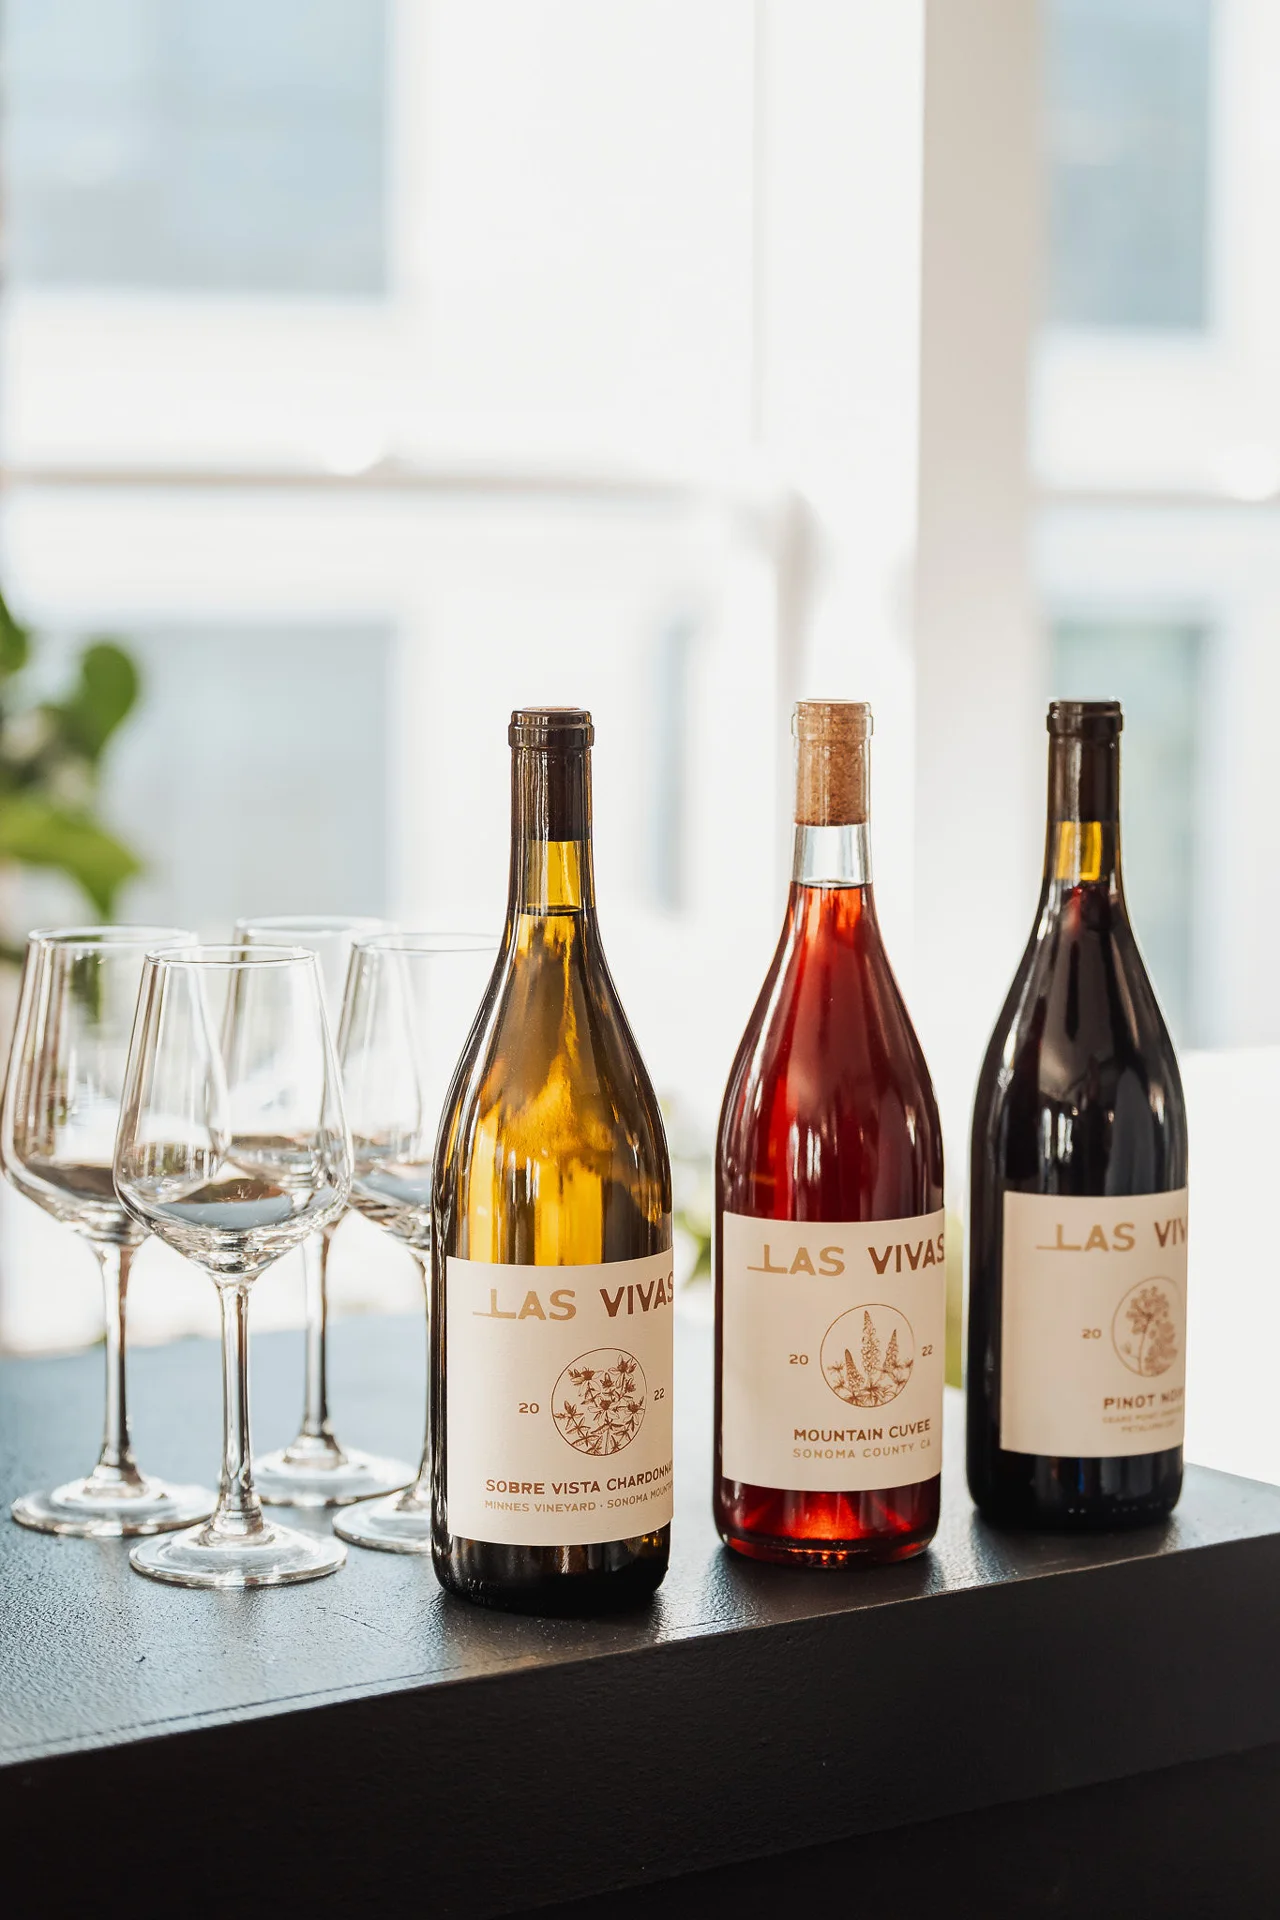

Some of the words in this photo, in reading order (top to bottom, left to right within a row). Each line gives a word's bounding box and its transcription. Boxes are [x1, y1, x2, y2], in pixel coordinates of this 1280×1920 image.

[1036, 1222, 1136, 1252] LAS
[747, 1244, 845, 1277] LAS
[867, 1233, 944, 1275] VIVAS
[472, 1288, 577, 1321] LAS
[600, 1271, 673, 1318] VIVAS
[1082, 1329, 1102, 1339] 20
[789, 1354, 809, 1366] 20
[922, 1344, 933, 1357] 22
[518, 1402, 540, 1414] 20
[653, 1387, 665, 1401] 22
[1103, 1394, 1156, 1410] PINOT
[793, 1428, 883, 1442] MOUNTAIN
[889, 1418, 931, 1439] CUVEE
[793, 1447, 856, 1459] SONOMA
[863, 1443, 915, 1459] COUNTY
[920, 1438, 931, 1450] CA
[485, 1479, 545, 1495] SOBRE
[551, 1480, 600, 1495] VISTA
[485, 1500, 530, 1512] MINNES
[534, 1501, 596, 1513] VINEYARD
[607, 1493, 648, 1509] SONOMA
